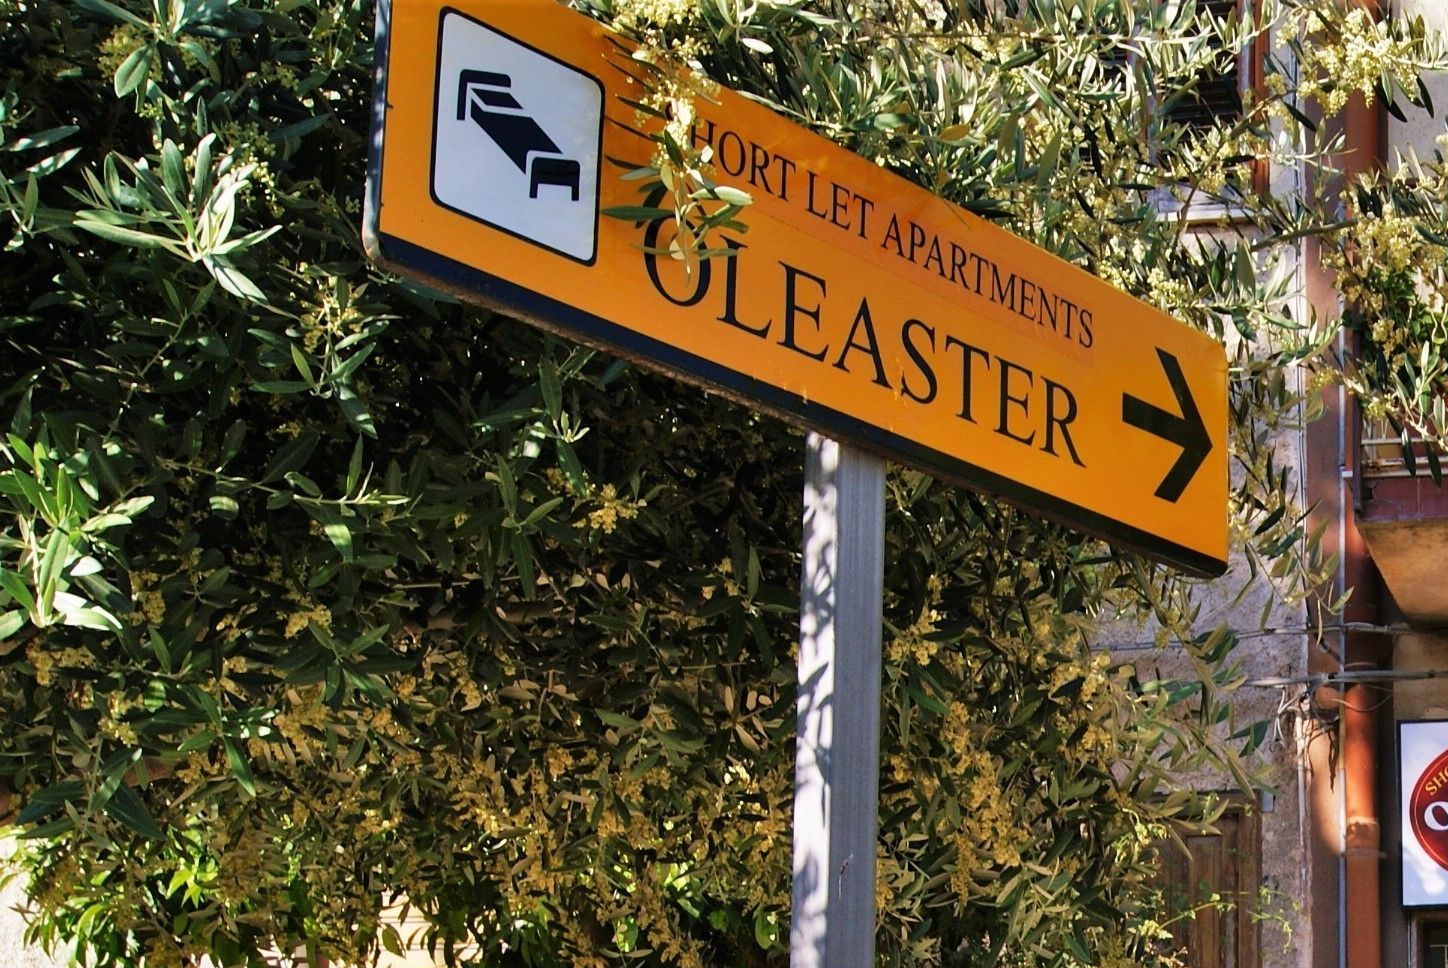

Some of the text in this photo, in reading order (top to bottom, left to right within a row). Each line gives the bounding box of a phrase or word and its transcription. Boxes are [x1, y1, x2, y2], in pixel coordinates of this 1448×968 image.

[643, 212, 1087, 469] OLEASTER
[665, 102, 1094, 348] HORT LET APARTMENTS
